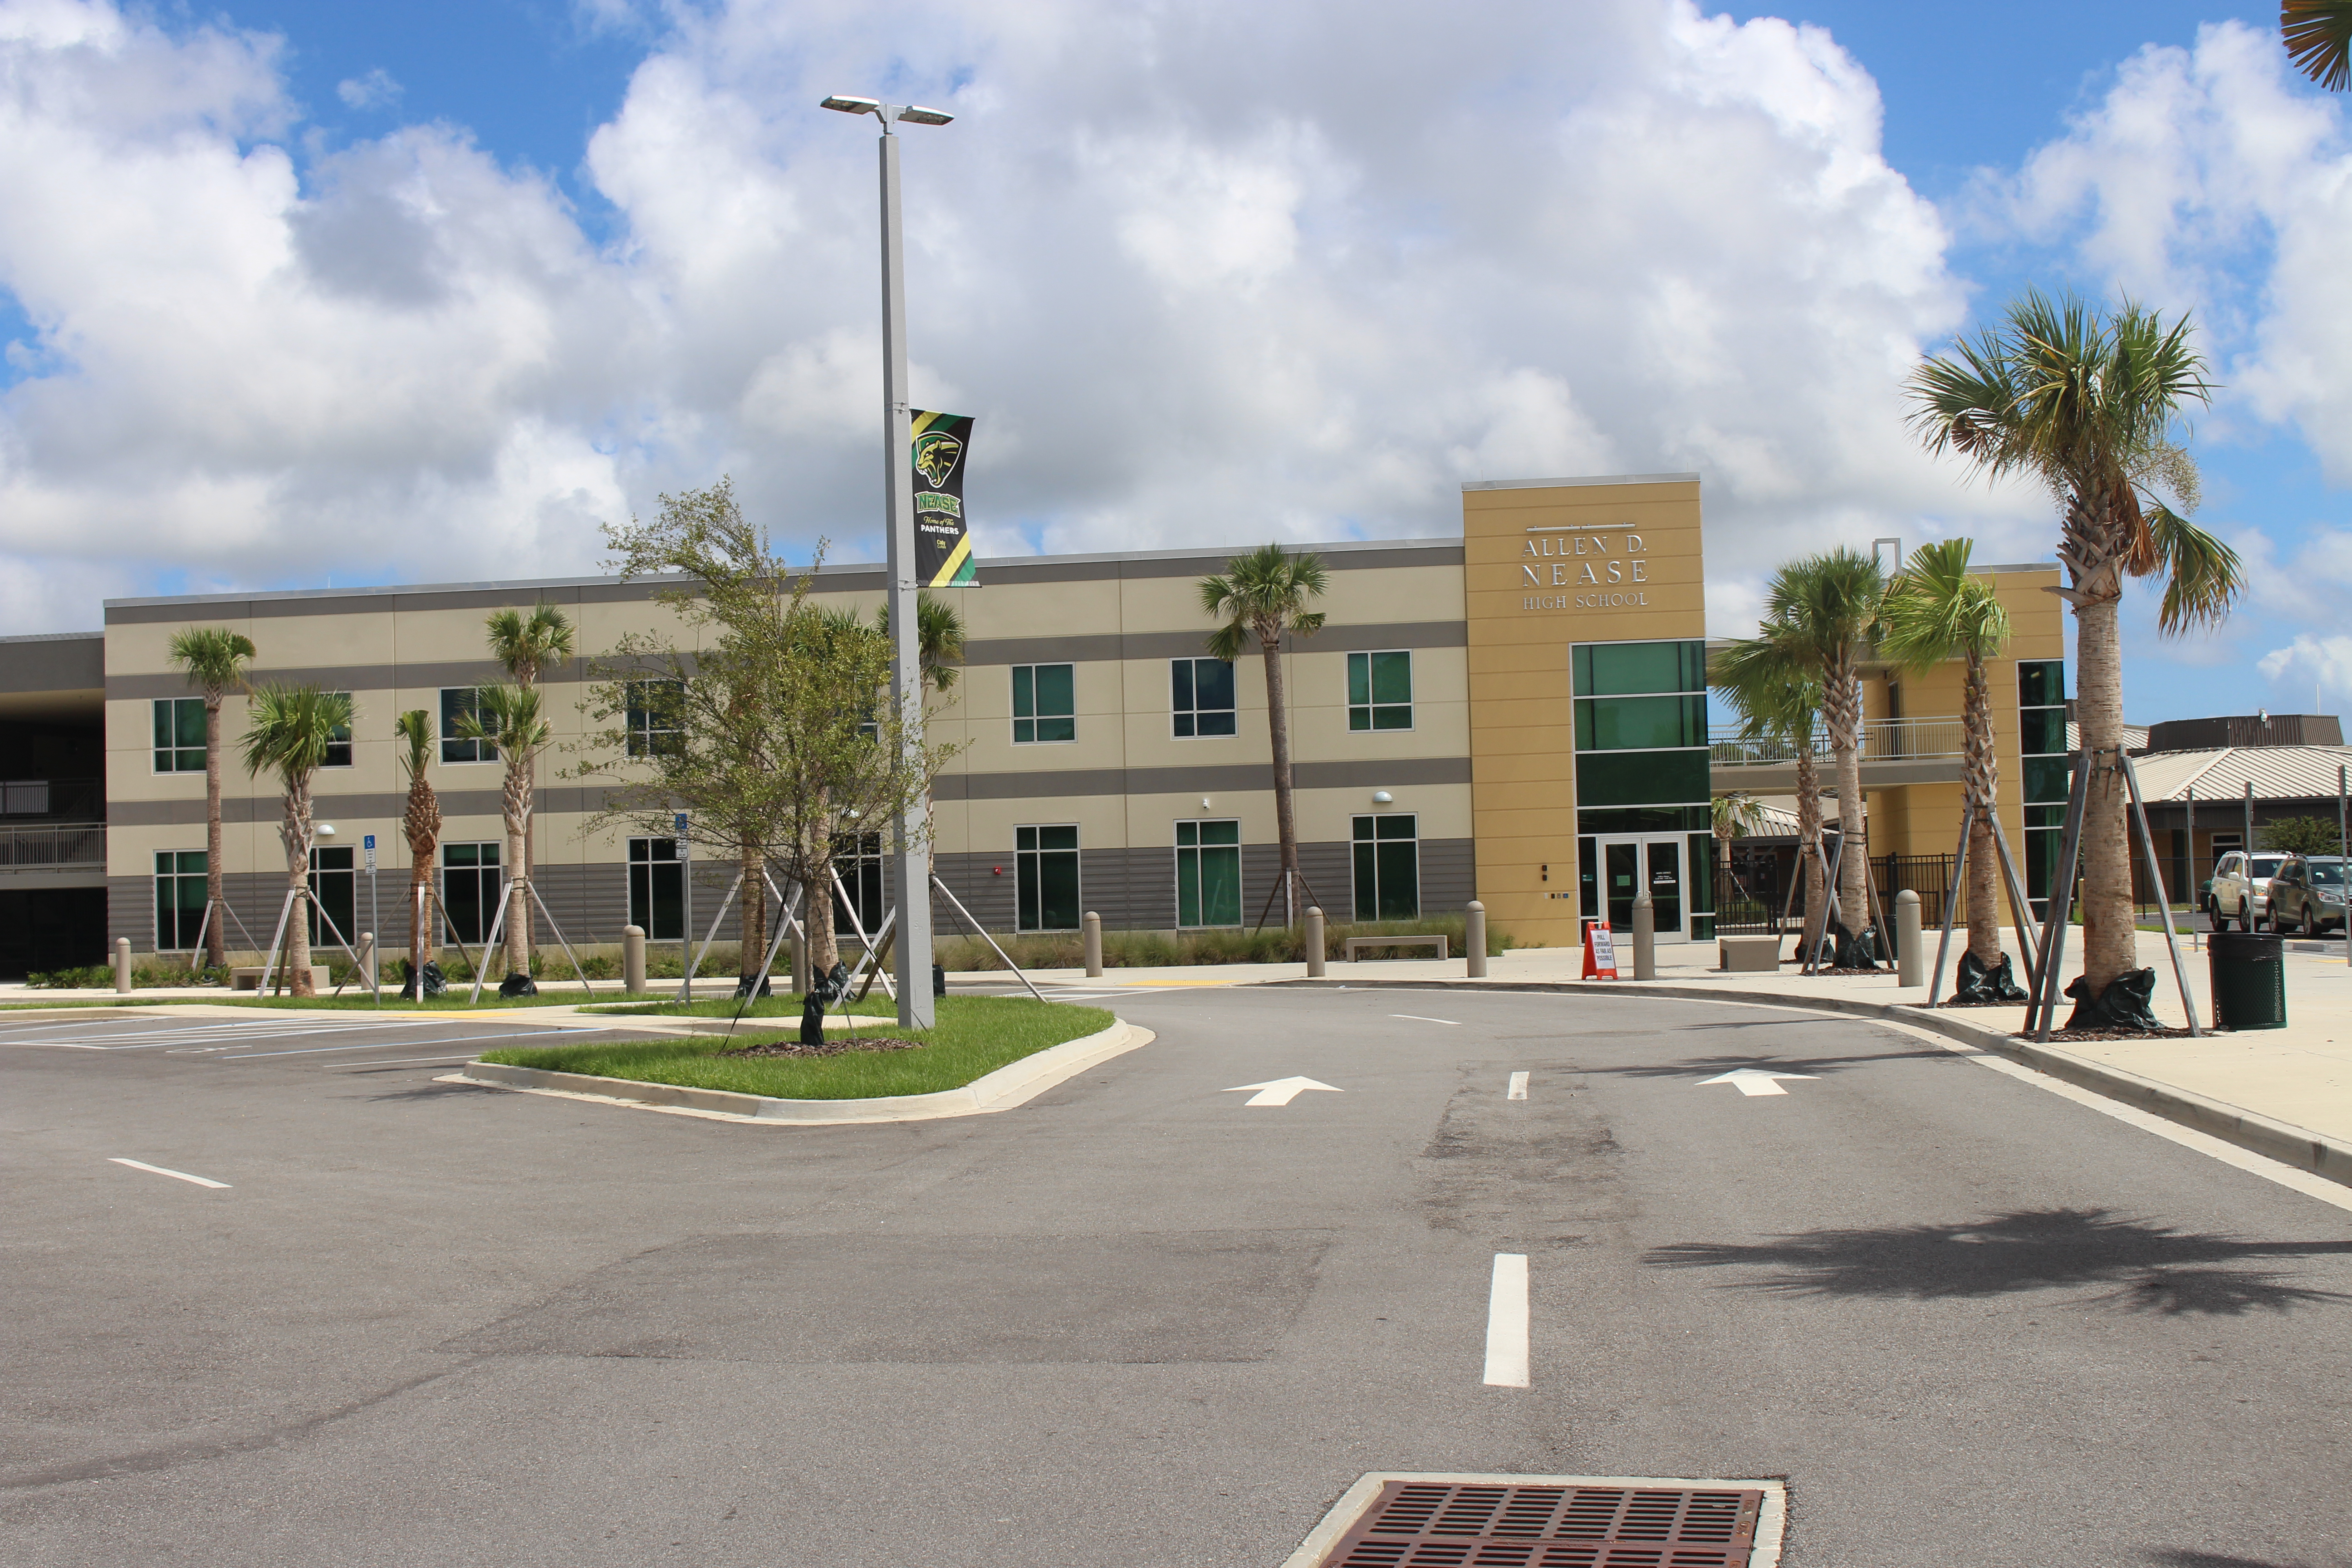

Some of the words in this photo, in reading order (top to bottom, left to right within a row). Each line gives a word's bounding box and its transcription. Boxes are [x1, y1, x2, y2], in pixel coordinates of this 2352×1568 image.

[917, 493, 959, 515] NEASE
[921, 524, 959, 534] PANTHERS
[1522, 536, 1607, 557] ALLEN
[1627, 534, 1647, 553] D.
[1522, 560, 1648, 587] NEASE
[1523, 595, 1566, 610] HIGH
[1576, 593, 1649, 608] SCHOOL
